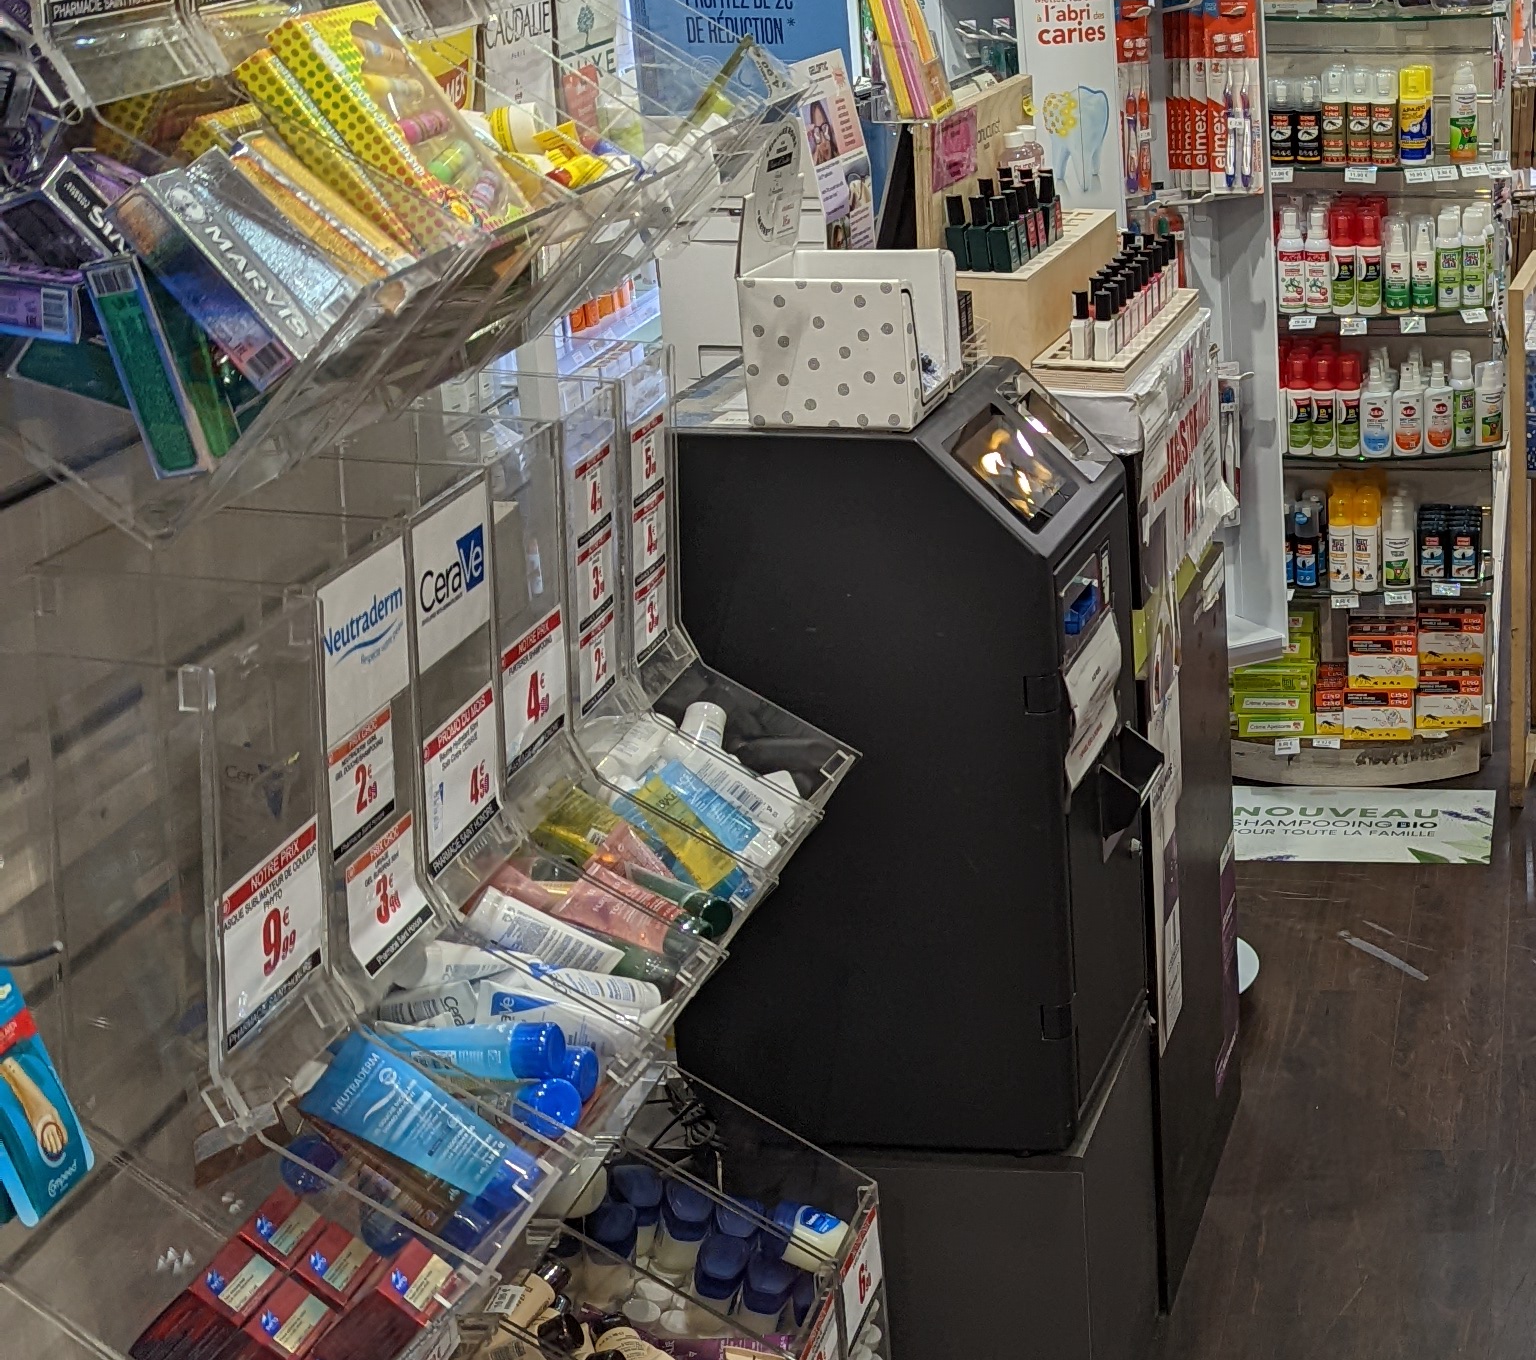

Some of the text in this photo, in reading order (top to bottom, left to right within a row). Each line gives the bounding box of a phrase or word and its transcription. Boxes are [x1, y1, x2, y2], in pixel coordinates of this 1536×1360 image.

[686, 10, 784, 45] DE RÉDUCTION
[1037, 21, 1106, 45] caries
[1195, 108, 1208, 166] elmex
[204, 224, 310, 339] MARVIS
[420, 539, 484, 613] CeraVe
[1233, 806, 1439, 820] NOUVEAU
[1233, 819, 1439, 830] SHAMPOOING BIO
[1281, 828, 1339, 837] TOUTE
[1343, 829, 1363, 837] LA
[1368, 829, 1437, 838] FAMILLE
[250, 838, 300, 889] NOTRE PRIX
[331, 1051, 381, 1114] NEUTRADERM
